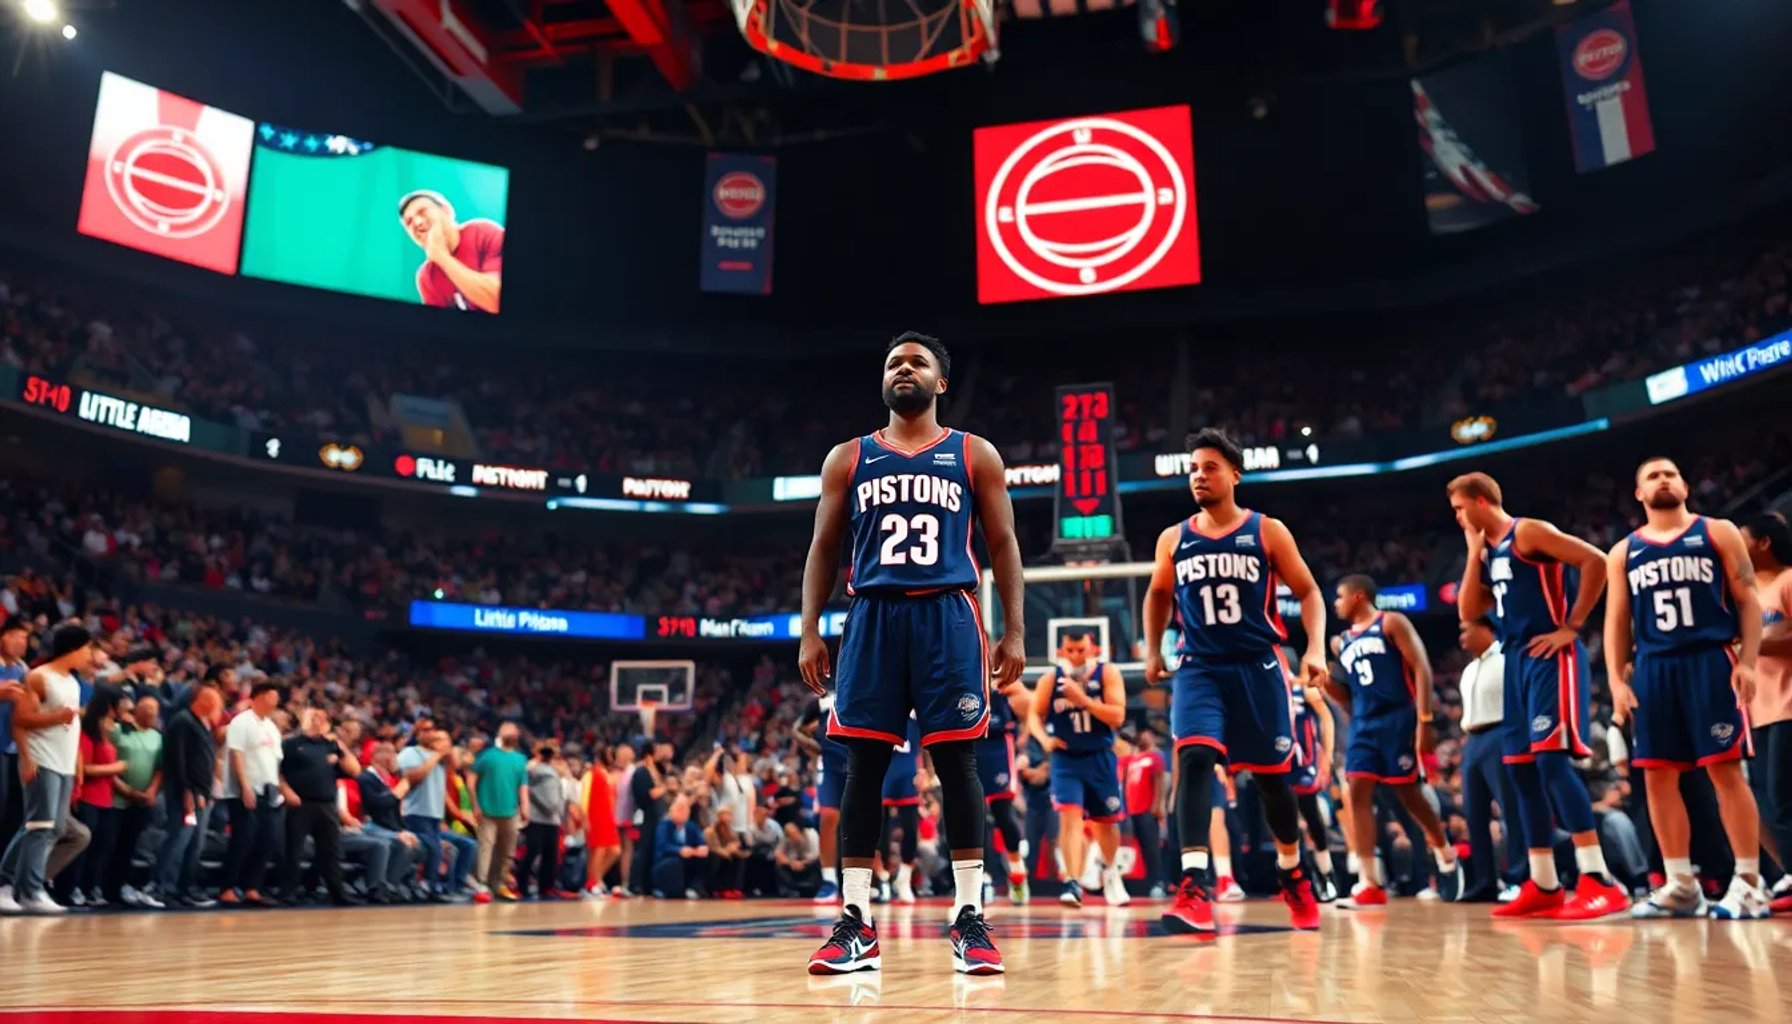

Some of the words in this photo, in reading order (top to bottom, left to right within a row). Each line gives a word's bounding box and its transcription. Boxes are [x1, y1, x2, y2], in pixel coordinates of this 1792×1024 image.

[79, 390, 139, 430] LITTLE
[857, 473, 963, 513] PISTONS
[879, 512, 940, 566] 23
[1175, 552, 1260, 586] PISTONS
[1628, 555, 1714, 596] PISTONS
[1199, 582, 1243, 626] 13
[1653, 587, 1695, 632] 51
